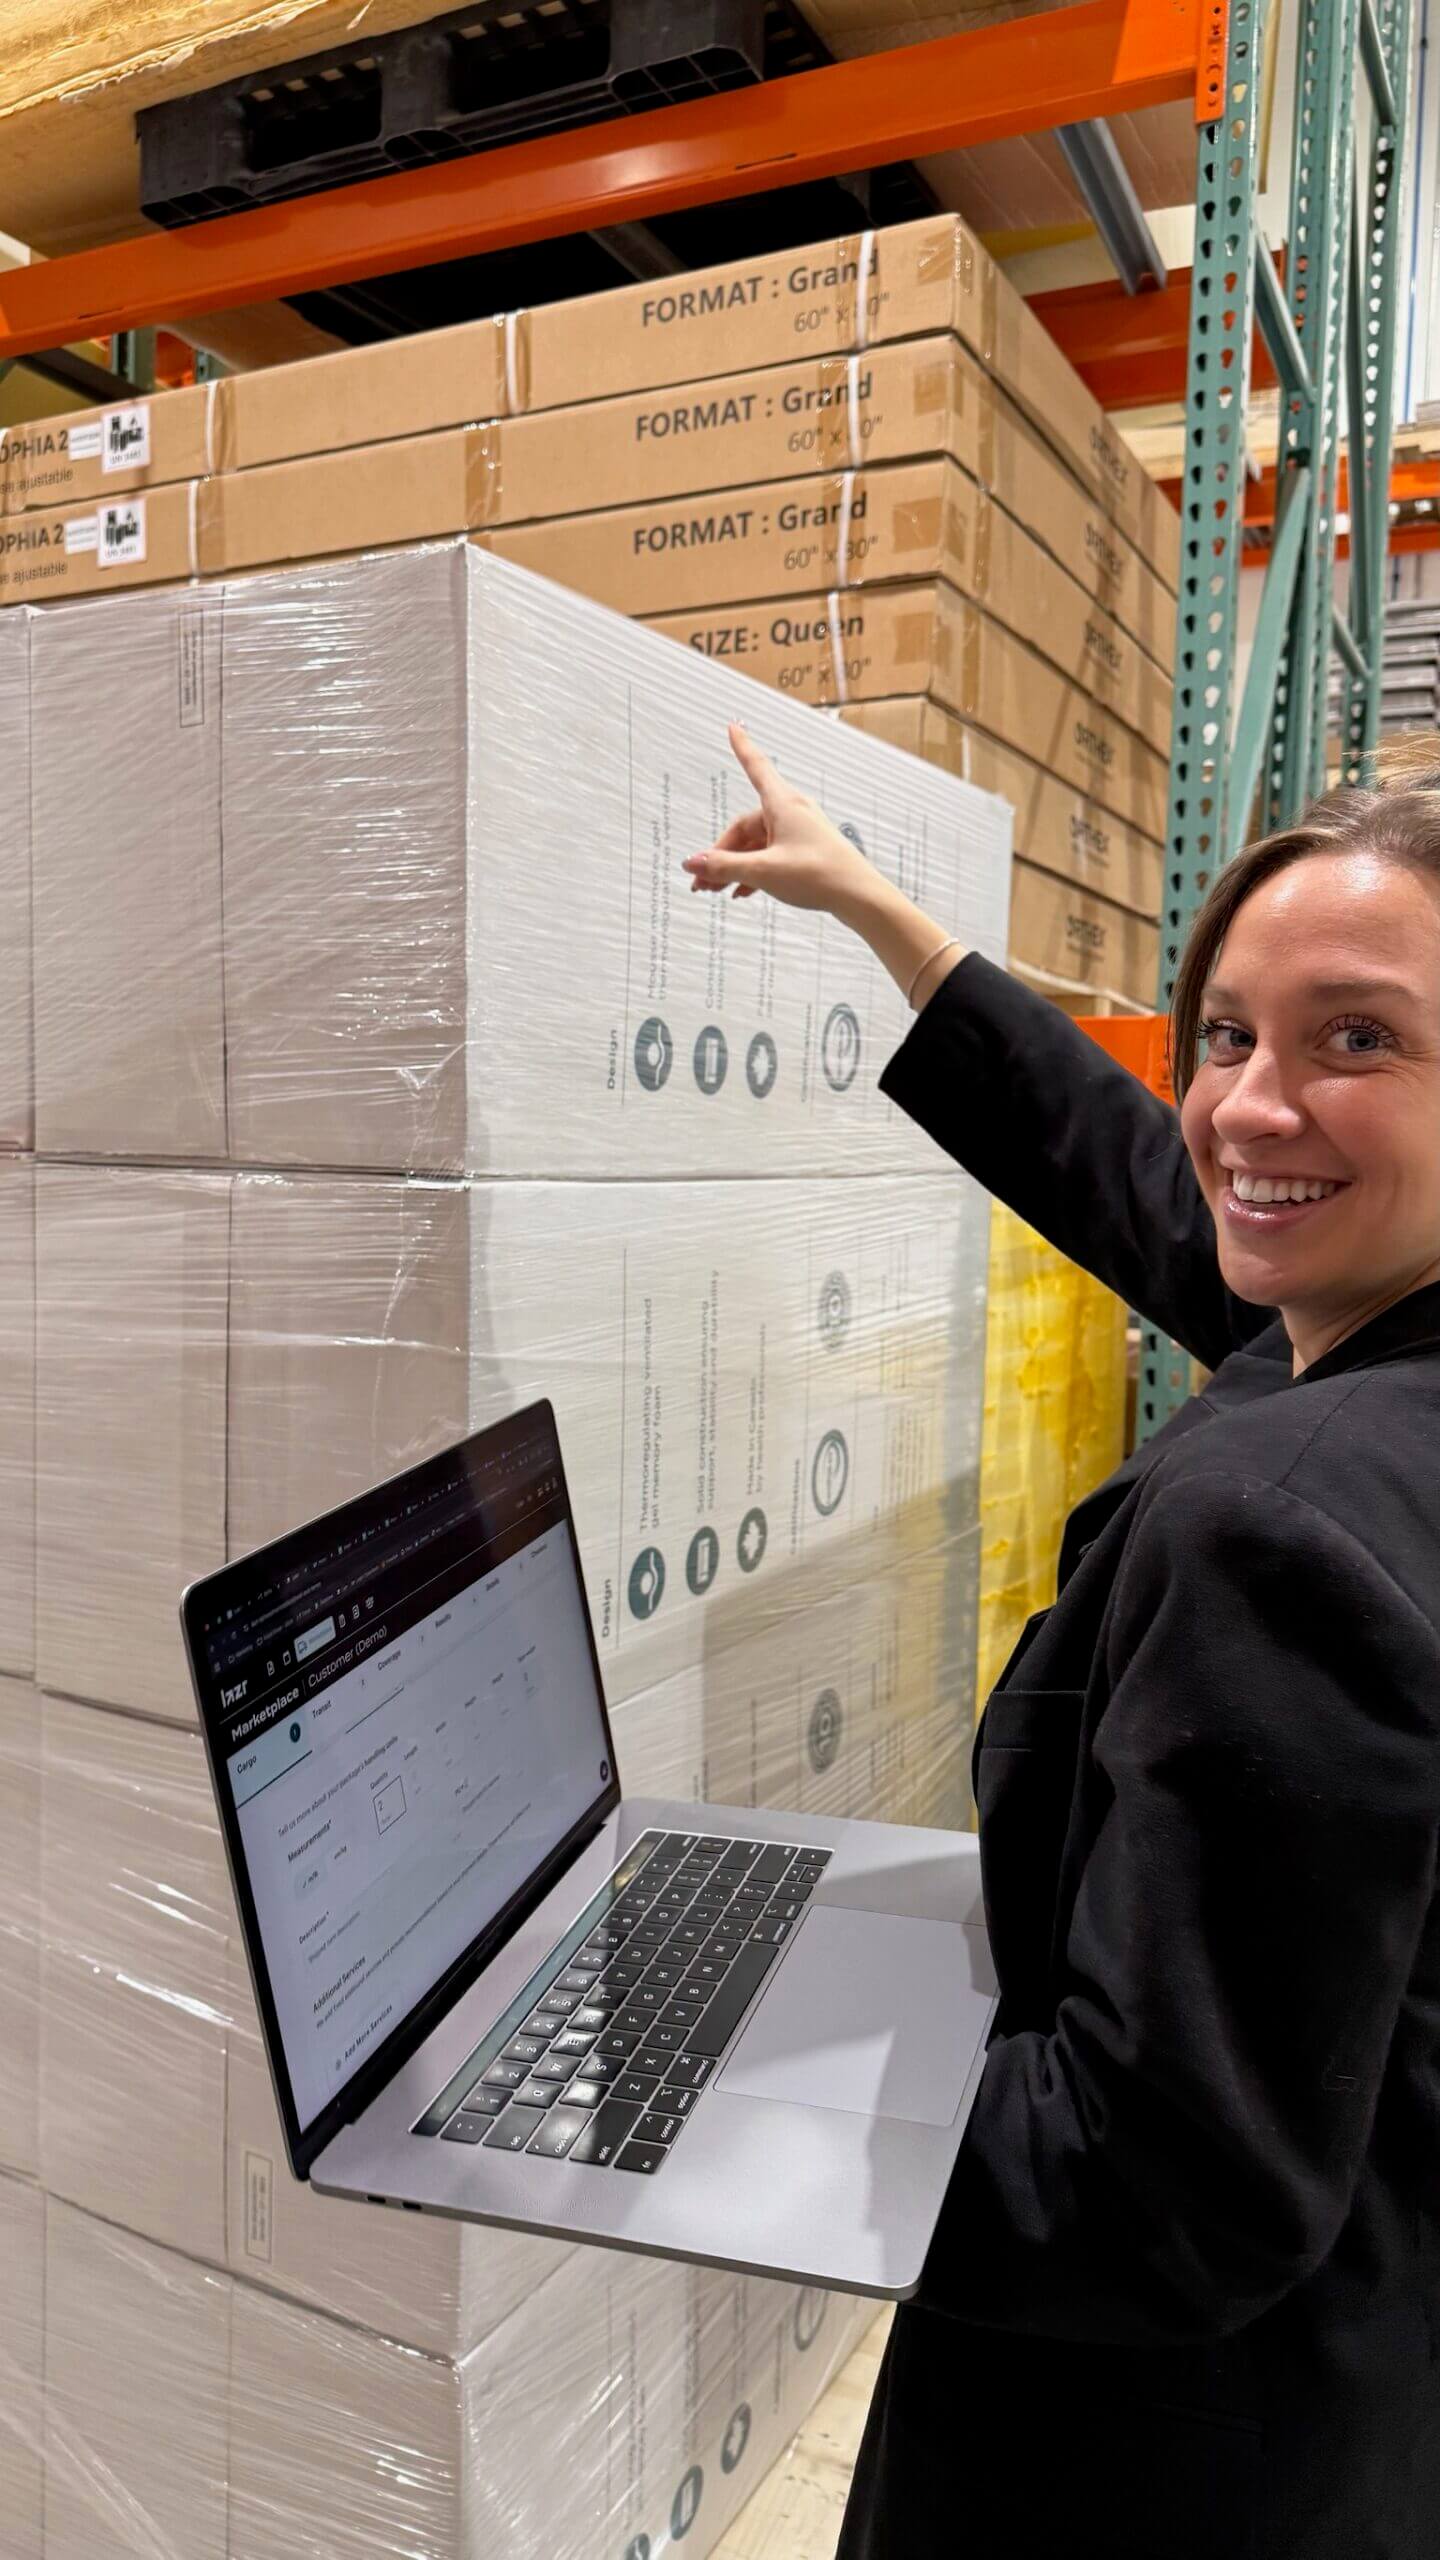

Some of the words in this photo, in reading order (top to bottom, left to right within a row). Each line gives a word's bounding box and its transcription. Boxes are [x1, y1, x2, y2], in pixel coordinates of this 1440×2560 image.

[642, 276, 763, 327] FORMAT
[59, 429, 69, 451] 2
[636, 395, 756, 442] FORMAT
[54, 523, 65, 545] 2
[633, 511, 753, 555] FORMAT
[607, 1029, 618, 1090] Design
[642, 1297, 652, 1380] ventilated
[700, 1300, 709, 1368] ensuring
[652, 1385, 662, 1427] foam
[698, 1371, 707, 1470] construction
[708, 1381, 717, 1442] stability
[640, 1385, 652, 1534] Thermoregulating
[652, 1431, 662, 1499] memory
[652, 1503, 660, 1528] gel
[696, 1475, 705, 1514] Solid
[602, 1578, 612, 1638] Design
[231, 1688, 299, 1741] Marketplace
[308, 1648, 354, 1687] Customer
[355, 1625, 388, 1656] (Demo)
[312, 1700, 332, 1718] Transit
[237, 1755, 257, 1774] Cargo
[296, 1808, 311, 1823] more
[312, 1793, 326, 1811] about
[313, 1978, 342, 2013] Additional
[342, 1956, 365, 1982] Services
[356, 2029, 370, 2047] More
[370, 2004, 393, 2030] Services
[660, 2033, 672, 2041] C
[645, 2057, 657, 2065] X
[629, 2083, 641, 2091] Z
